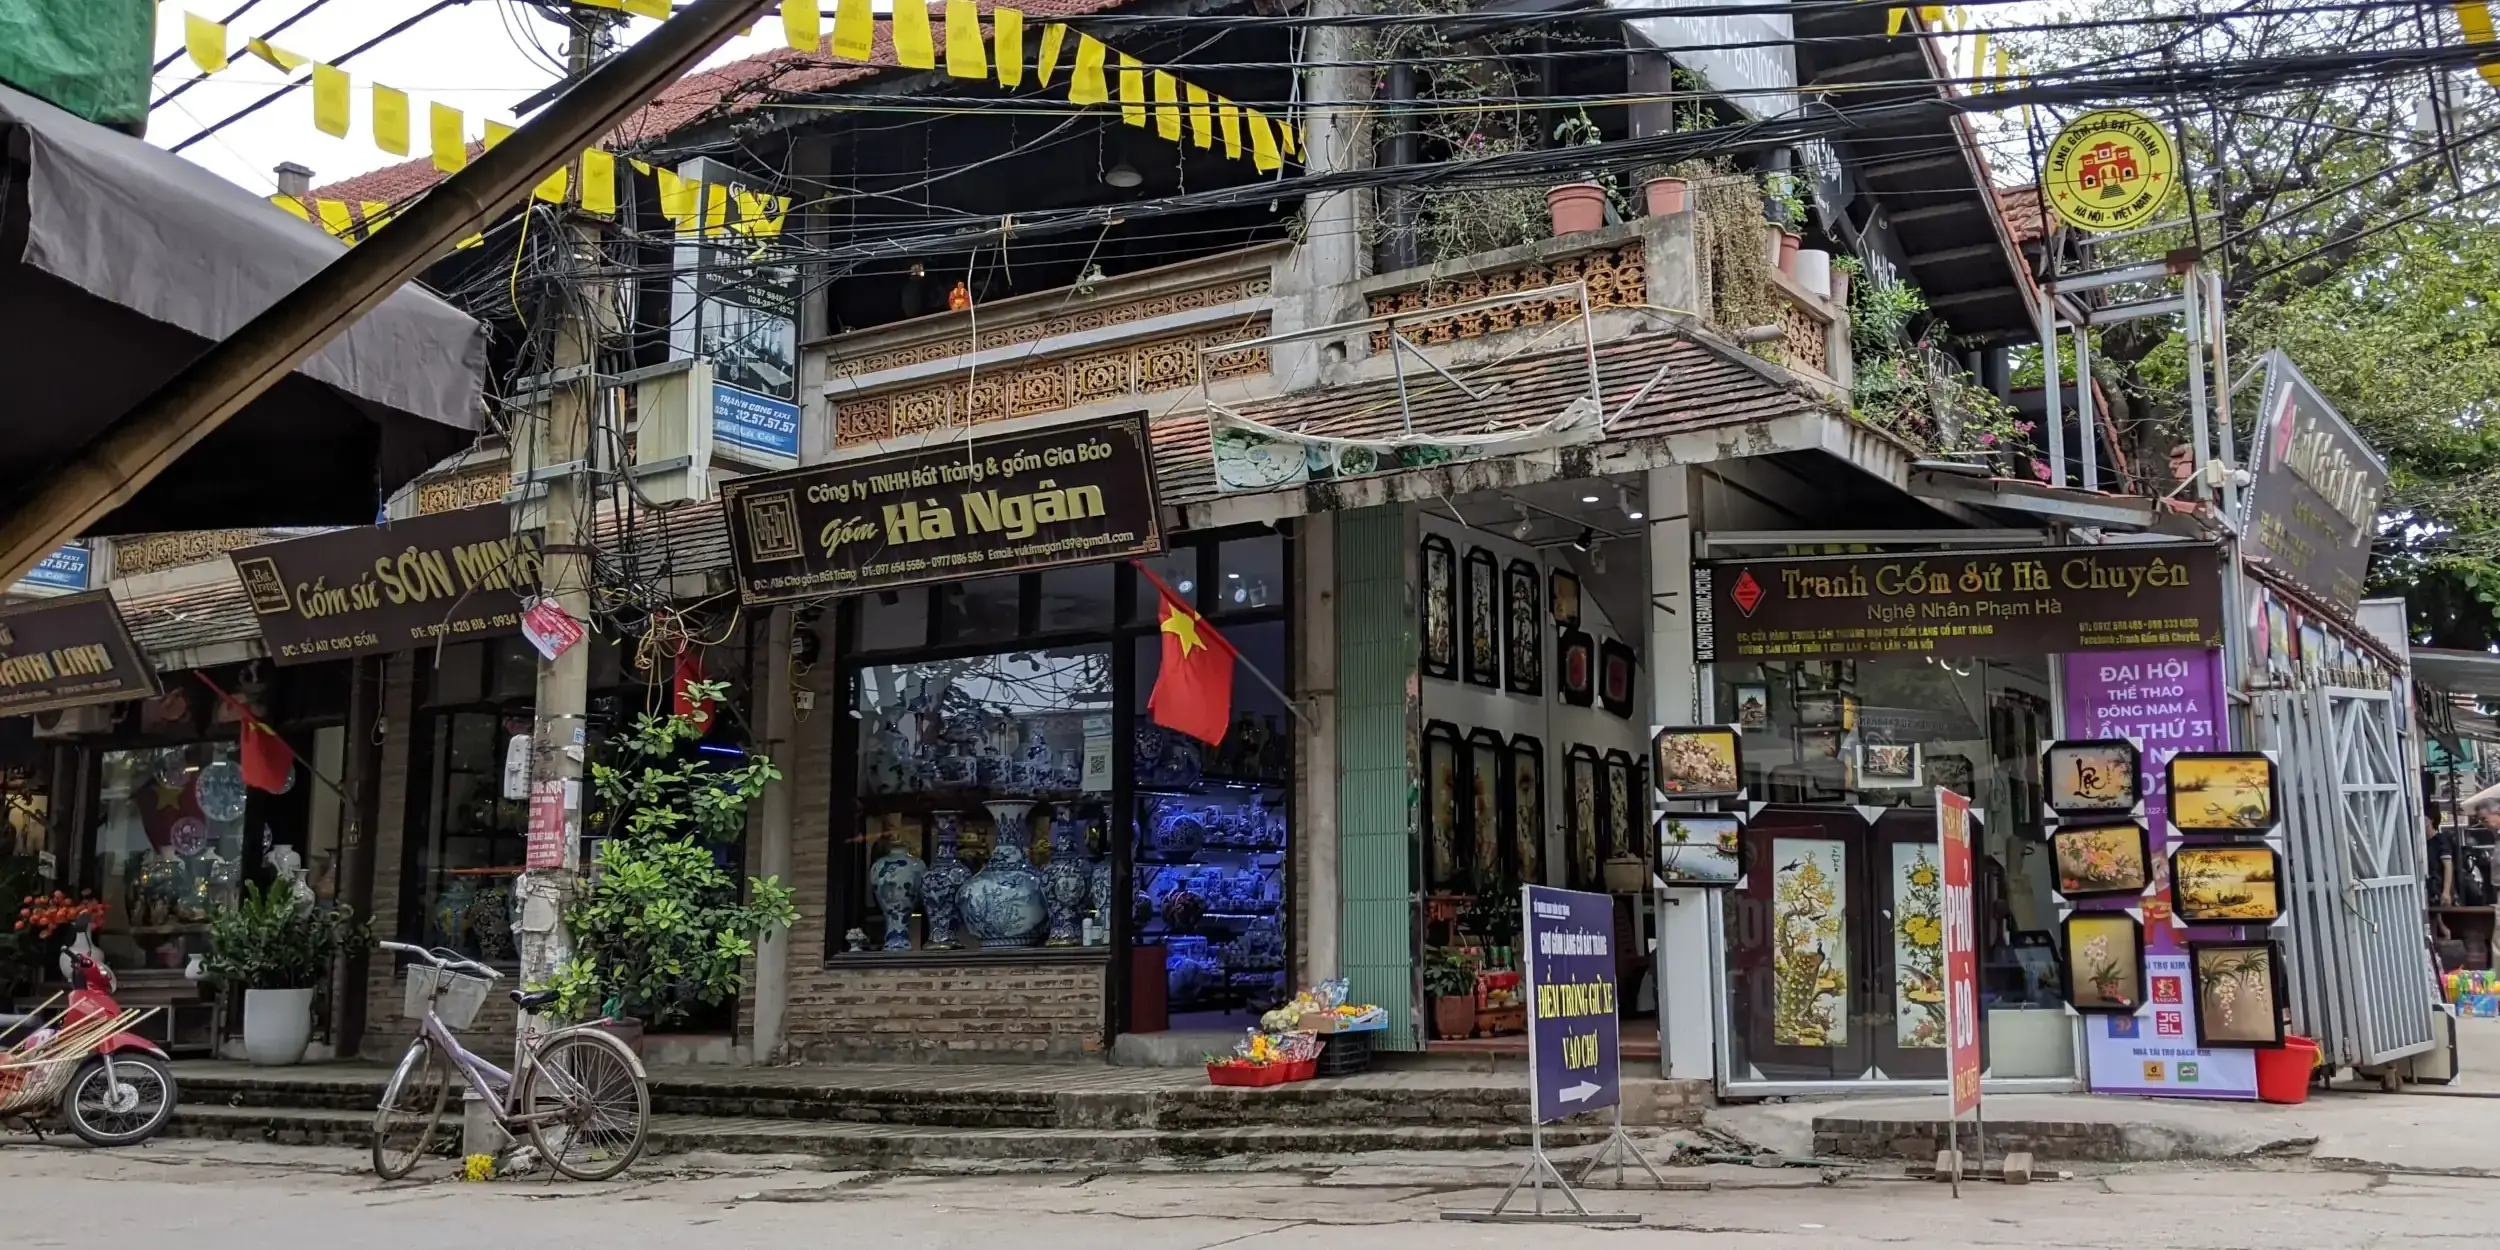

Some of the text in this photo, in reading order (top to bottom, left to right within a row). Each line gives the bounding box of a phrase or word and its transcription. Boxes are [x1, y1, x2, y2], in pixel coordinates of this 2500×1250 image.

[2088, 209, 2105, 223] NỘI
[2112, 206, 2134, 221] VIỆT
[2133, 191, 2153, 213] NAM
[735, 409, 797, 434] 32.57.57.57
[773, 411, 792, 420] TAXI
[807, 437, 1112, 504] Công ty TNHH Bát Tràng & gốm Gia Bảo
[881, 498, 956, 547] Hà
[961, 477, 1106, 541] Ngân
[296, 575, 349, 620] Gốm
[351, 571, 381, 612] sứ
[375, 544, 456, 606] SƠN
[1781, 564, 1869, 600] Tranh
[1876, 560, 1952, 597] Gốm
[1959, 560, 2004, 593] Sứ
[2011, 559, 2052, 592] Hà
[2061, 556, 2190, 598] Chuyên
[1867, 598, 2063, 623] Nghệ Nhân Phạm Hà
[452, 619, 471, 634] 420
[52, 643, 115, 677] LINH
[2099, 658, 2190, 685] ĐẠI HỘI
[2108, 684, 2185, 701] THỂ THAO
[2097, 699, 2198, 719] ĐÔNG NAM Á
[2098, 719, 2213, 741] ẦN THỨ 31
[1945, 858, 1973, 952] PHỞ
[2170, 961, 2187, 970] KIM
[1537, 964, 1614, 1020] ĐIỂM TRÔNG GIỮ XE
[1955, 961, 1974, 1050] BÒ
[2159, 1023, 2181, 1033] BL
[2160, 1012, 2180, 1022] JG
[1562, 1025, 1599, 1075] VÀO CHỢ
